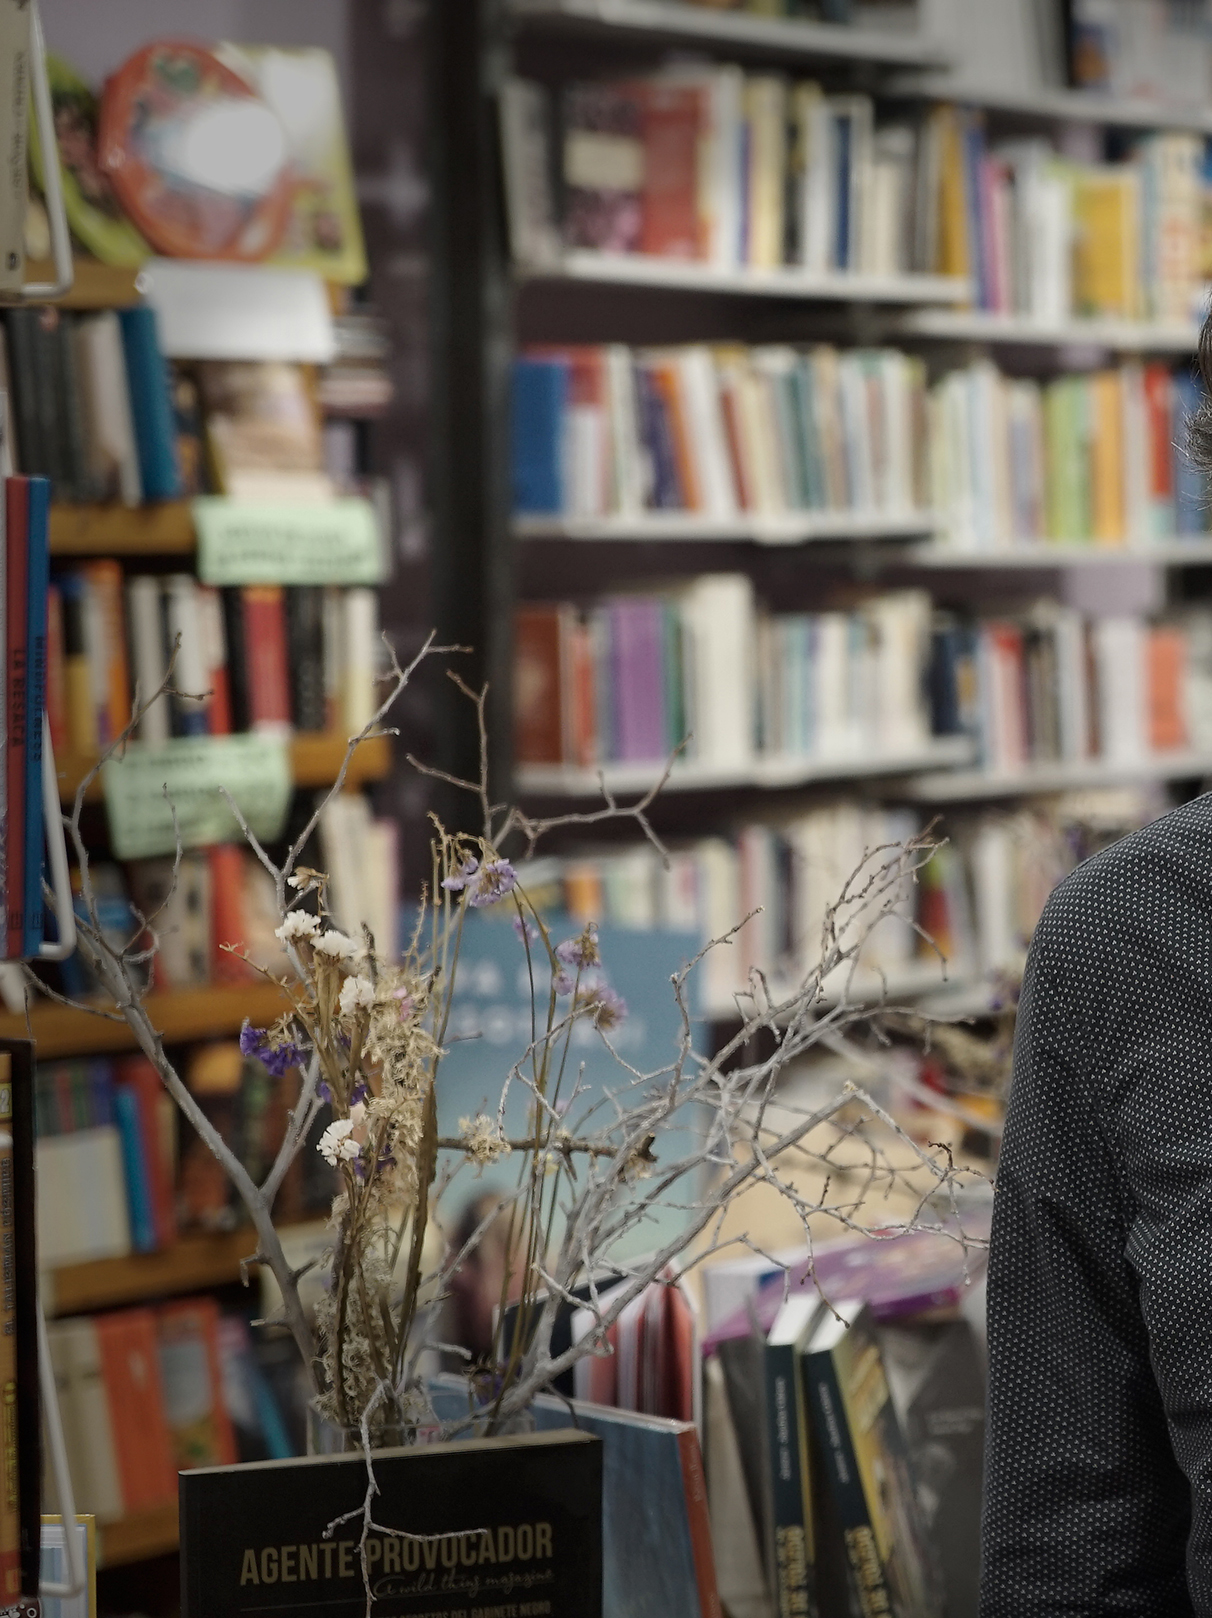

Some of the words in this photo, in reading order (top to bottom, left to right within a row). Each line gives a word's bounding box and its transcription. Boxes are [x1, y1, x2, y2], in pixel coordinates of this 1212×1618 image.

[13, 647, 25, 671] LA
[13, 678, 25, 747] RESACA
[240, 1540, 355, 1586] AGENTE
[364, 1522, 553, 1575] PROVOCADOR
[400, 1571, 437, 1595] wild
[440, 1566, 481, 1599] thing
[485, 1568, 556, 1595] magazine
